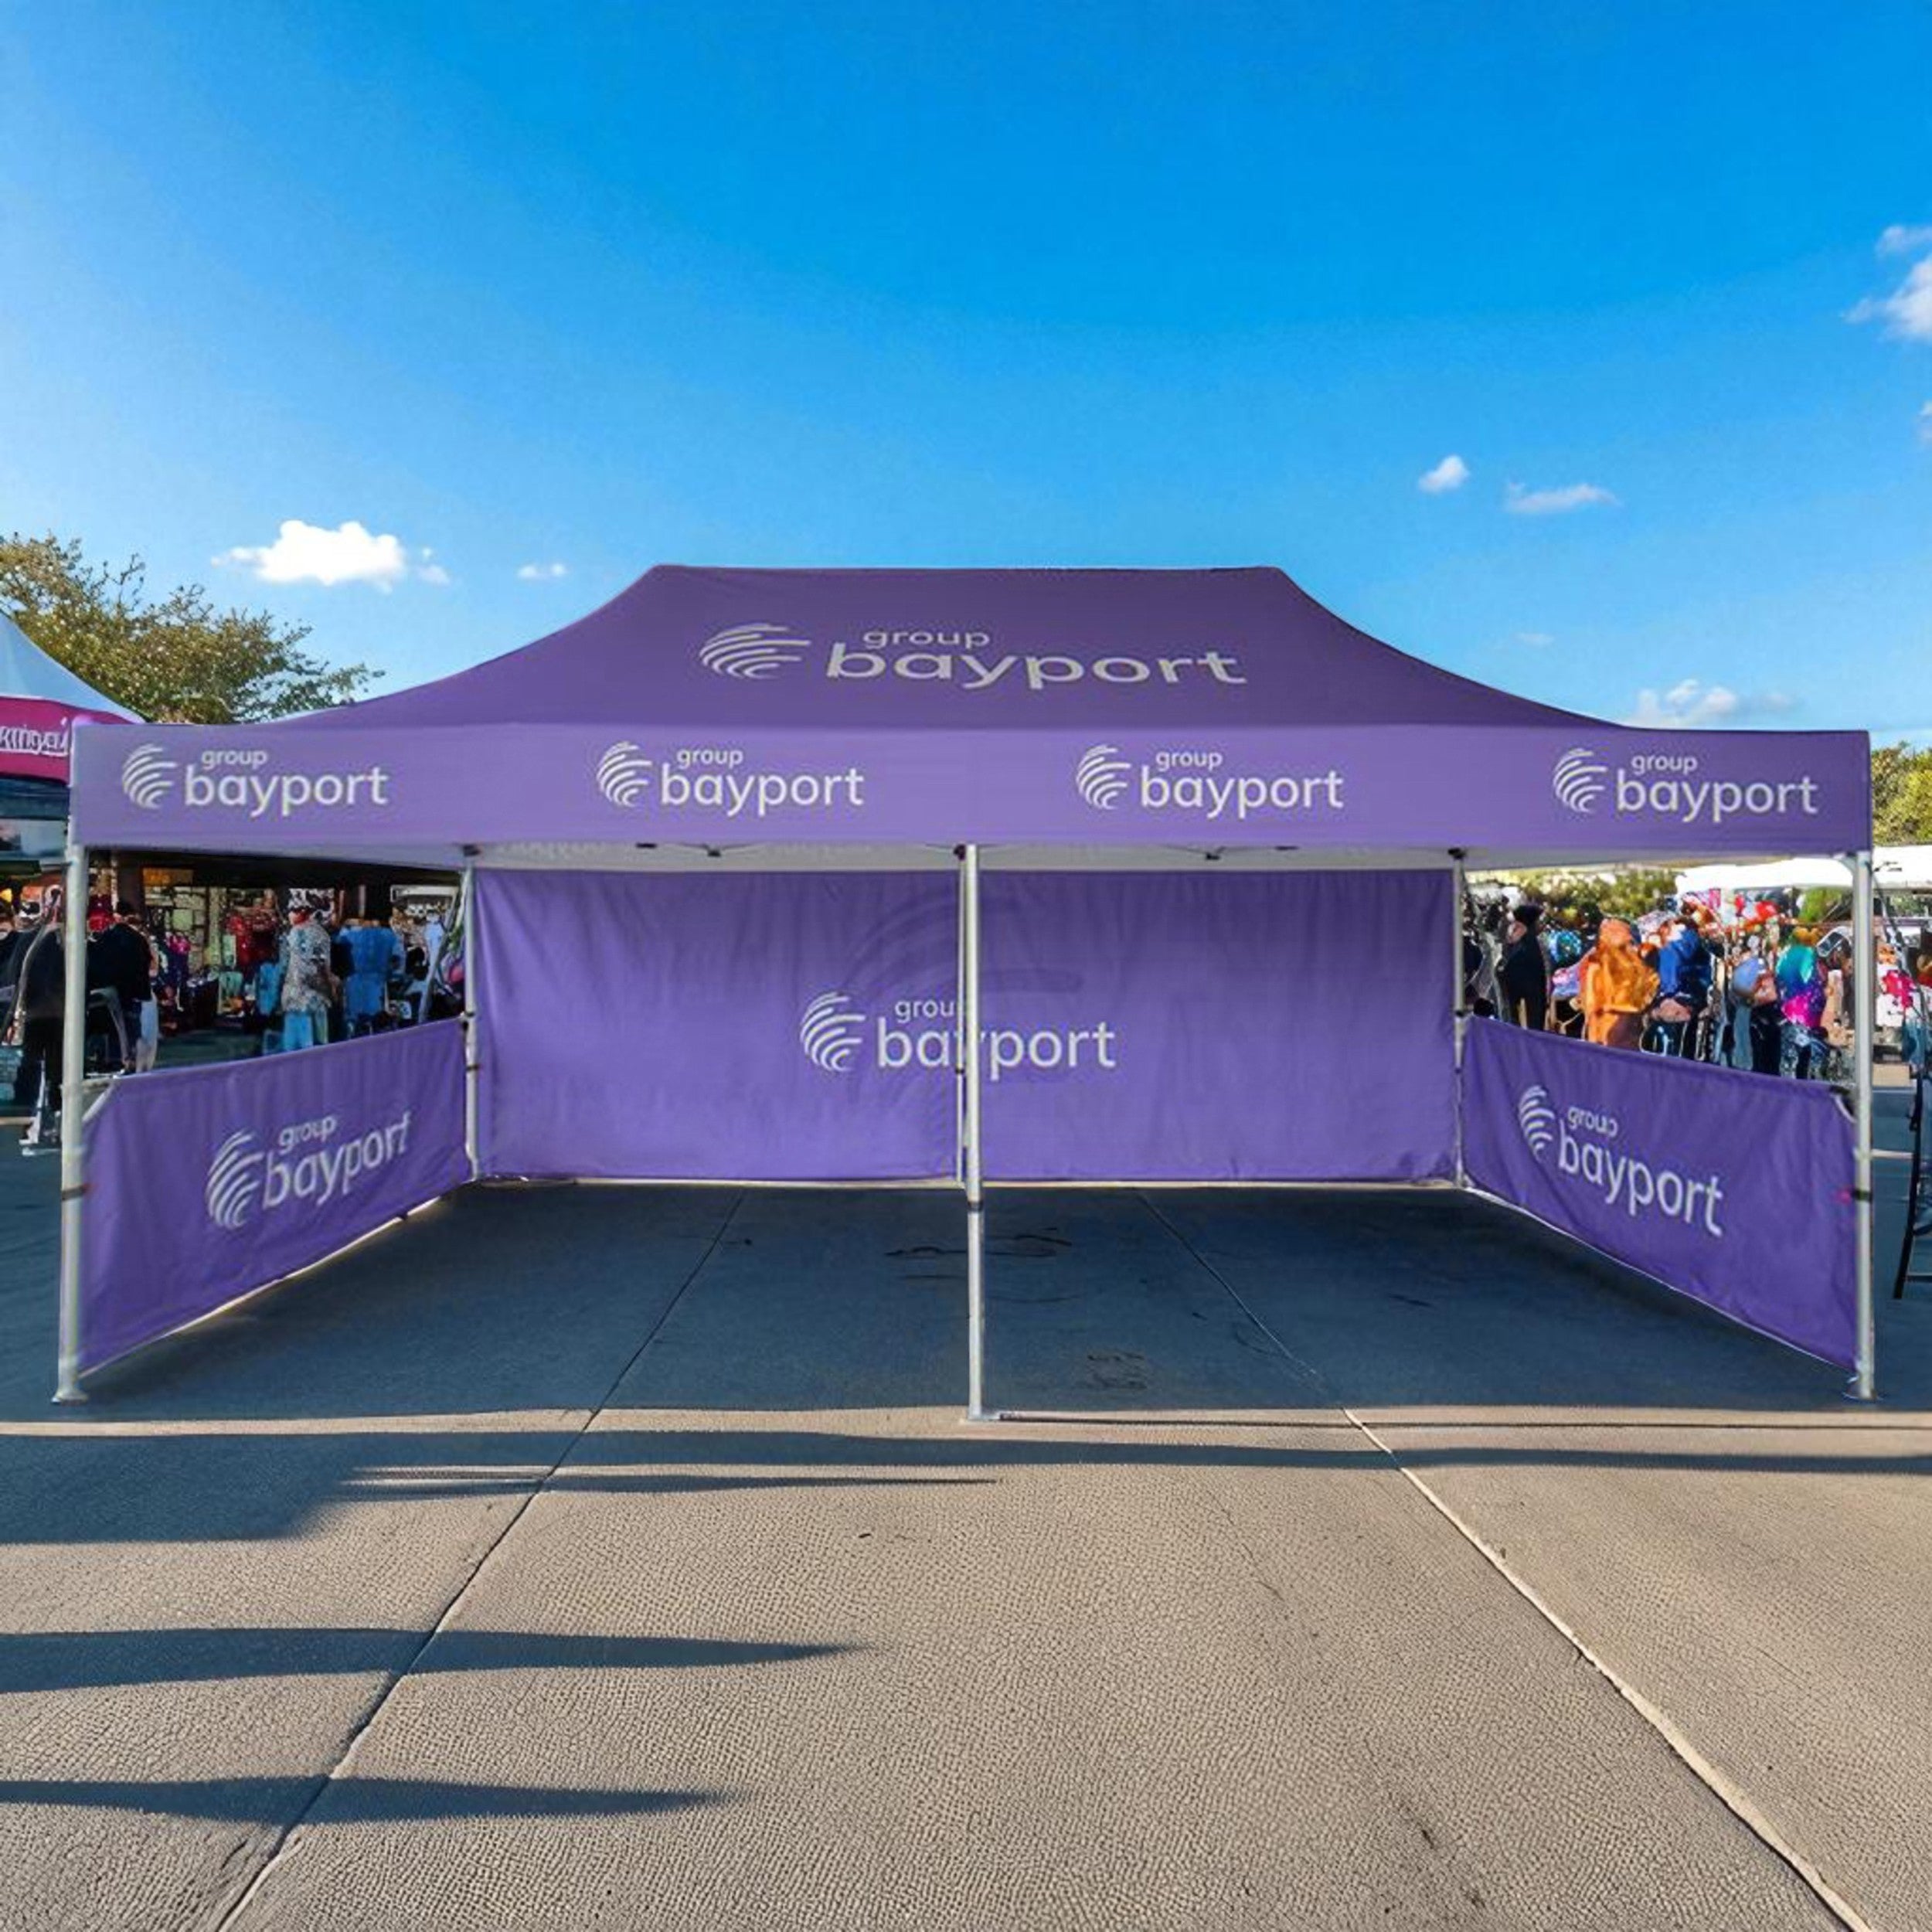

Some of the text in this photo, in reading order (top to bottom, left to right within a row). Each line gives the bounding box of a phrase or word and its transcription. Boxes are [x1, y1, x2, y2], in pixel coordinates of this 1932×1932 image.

[863, 628, 991, 649] group
[826, 643, 1247, 690] bayport
[202, 750, 267, 769] group
[677, 748, 743, 769] group
[1156, 750, 1223, 770] group
[1631, 754, 1698, 774] group
[184, 765, 388, 818] bayport
[661, 763, 865, 817] bayport
[1141, 766, 1345, 819] bayport
[1616, 769, 1818, 822] bayport
[894, 1000, 956, 1024] grou
[878, 1016, 1117, 1081] baport
[278, 1115, 337, 1155] group
[263, 1111, 411, 1210] bayport
[1558, 1118, 1723, 1236] bayport
